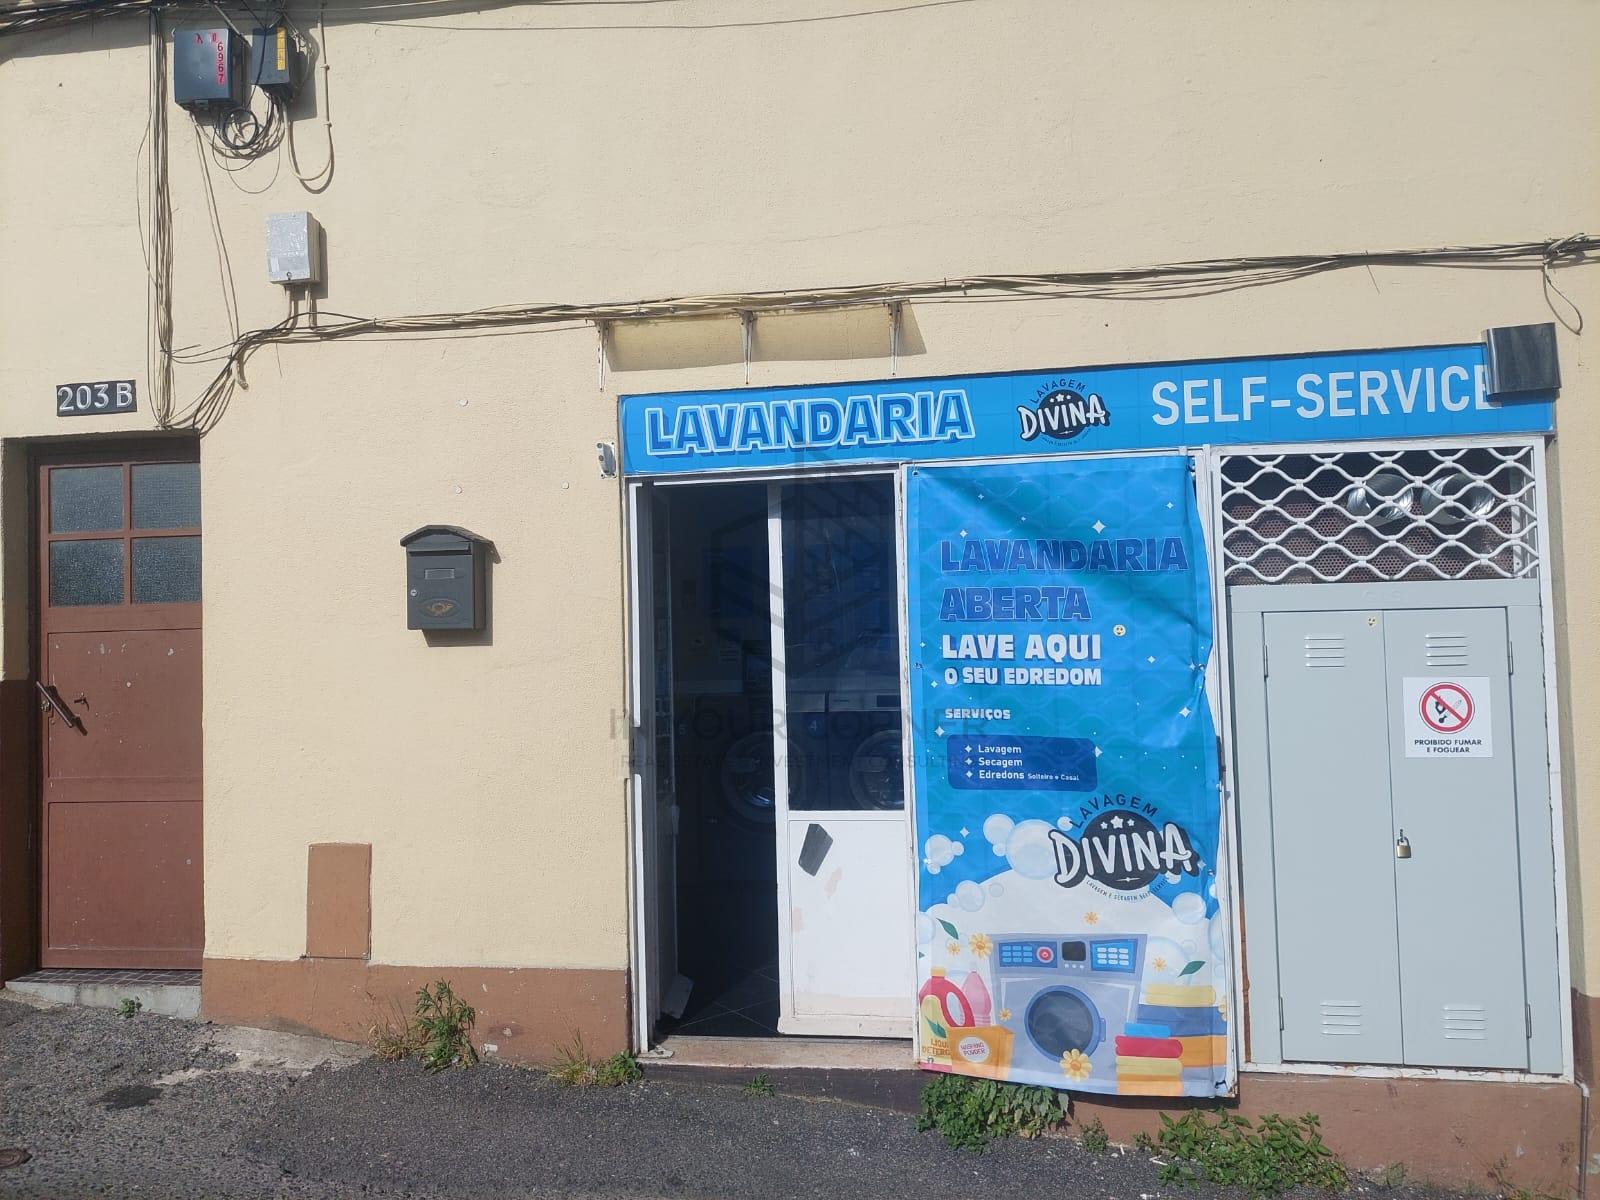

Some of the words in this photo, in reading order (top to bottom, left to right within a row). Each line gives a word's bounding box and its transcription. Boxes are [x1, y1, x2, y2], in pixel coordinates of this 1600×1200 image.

[57, 384, 109, 411] 203
[116, 382, 133, 408] B
[1030, 378, 1086, 404] LAVAGEM
[645, 390, 976, 458] LAVANDARIA
[1017, 394, 1110, 441] DIVINA
[939, 536, 1190, 575] LAVANDARIA
[938, 585, 1093, 622] ABERTA
[942, 634, 1015, 660] LAVE
[1024, 634, 1102, 664] AQUI
[944, 669, 958, 686] O
[963, 666, 999, 685] SEU
[1004, 667, 1103, 686] EDREDOM
[944, 708, 1012, 721] SERVIÇOS
[977, 743, 1022, 756] Lavagem
[1414, 739, 1452, 747] PROIBIDO
[1454, 739, 1482, 747] FUMAR
[977, 756, 1023, 769] Secagem
[978, 769, 1025, 780] Edredons
[1069, 793, 1158, 830] LAVAGEM
[1048, 821, 1200, 888] DIVINA
